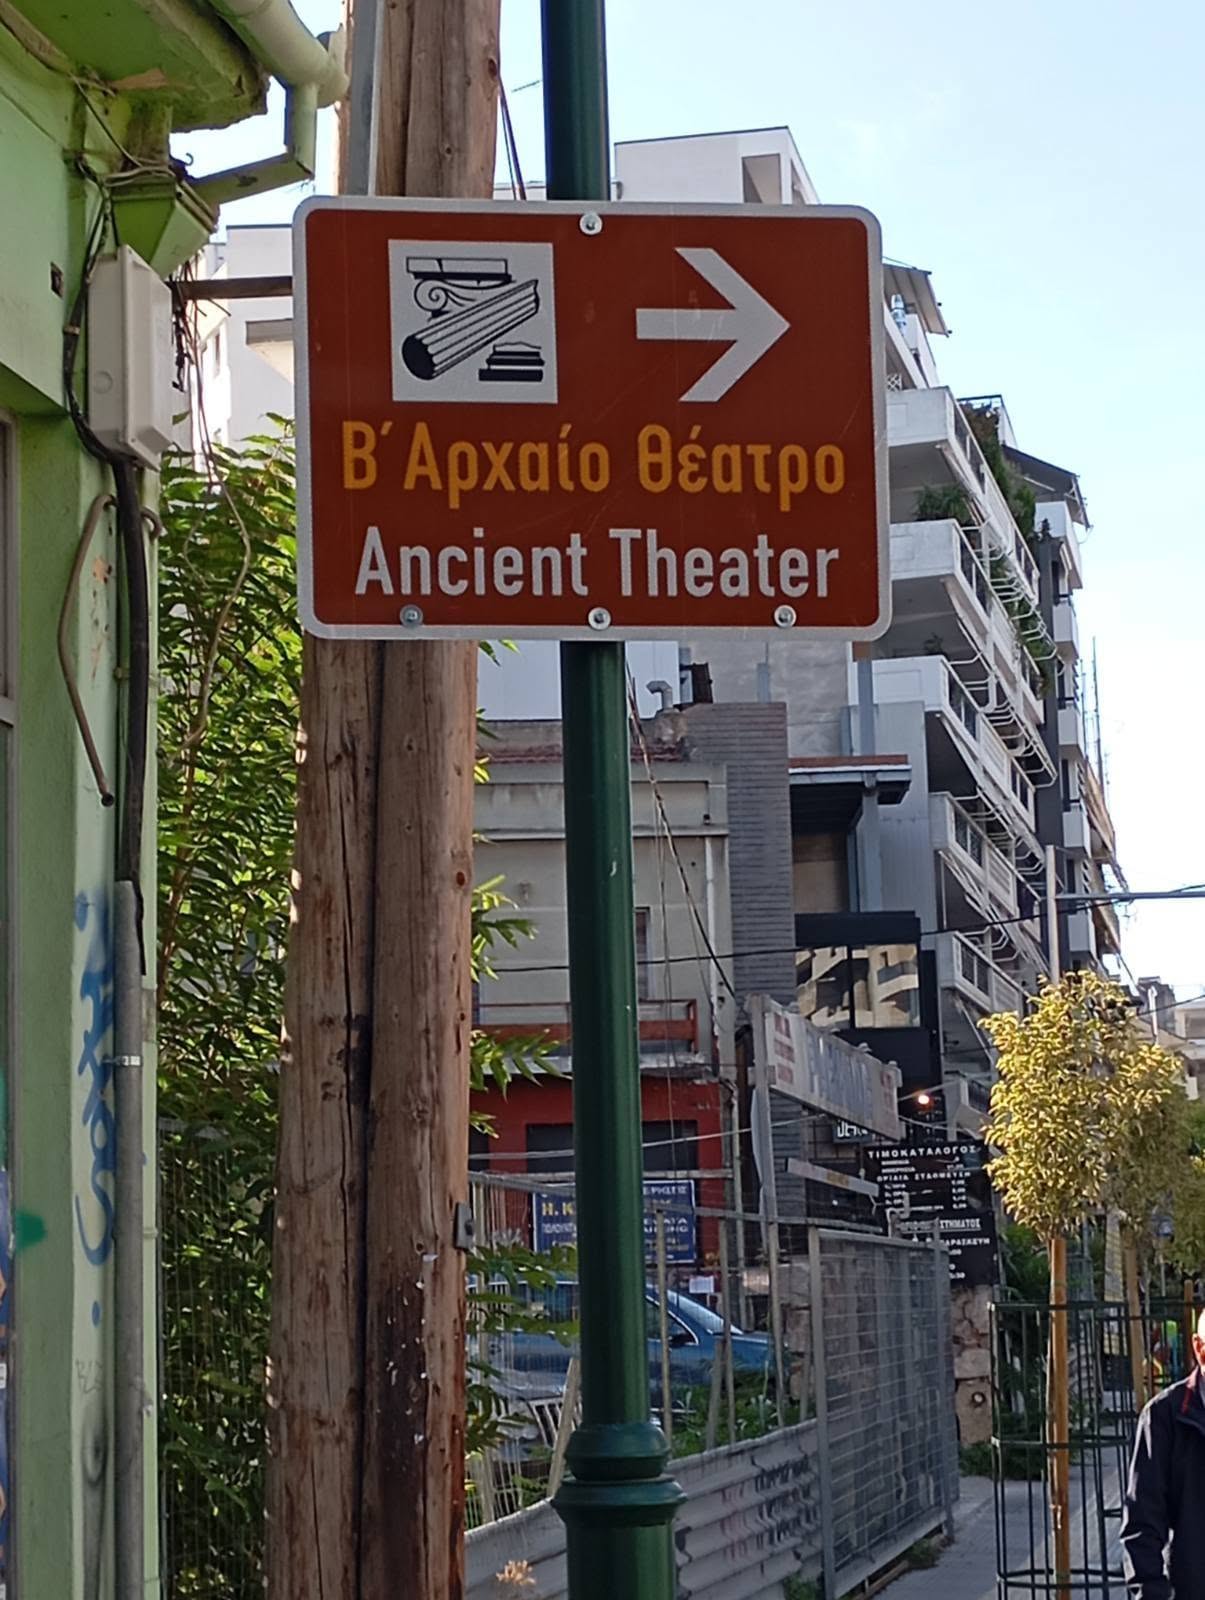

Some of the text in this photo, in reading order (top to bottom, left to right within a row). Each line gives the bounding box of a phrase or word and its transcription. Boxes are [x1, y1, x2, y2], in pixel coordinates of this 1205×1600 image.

[403, 420, 611, 510] Αρχαίο
[638, 424, 847, 513] Θέατρο
[354, 525, 840, 598] Ancient Theater
[868, 1145, 977, 1159] ΤΙΜΟΚΑΤΑΛΟΓΟΣ
